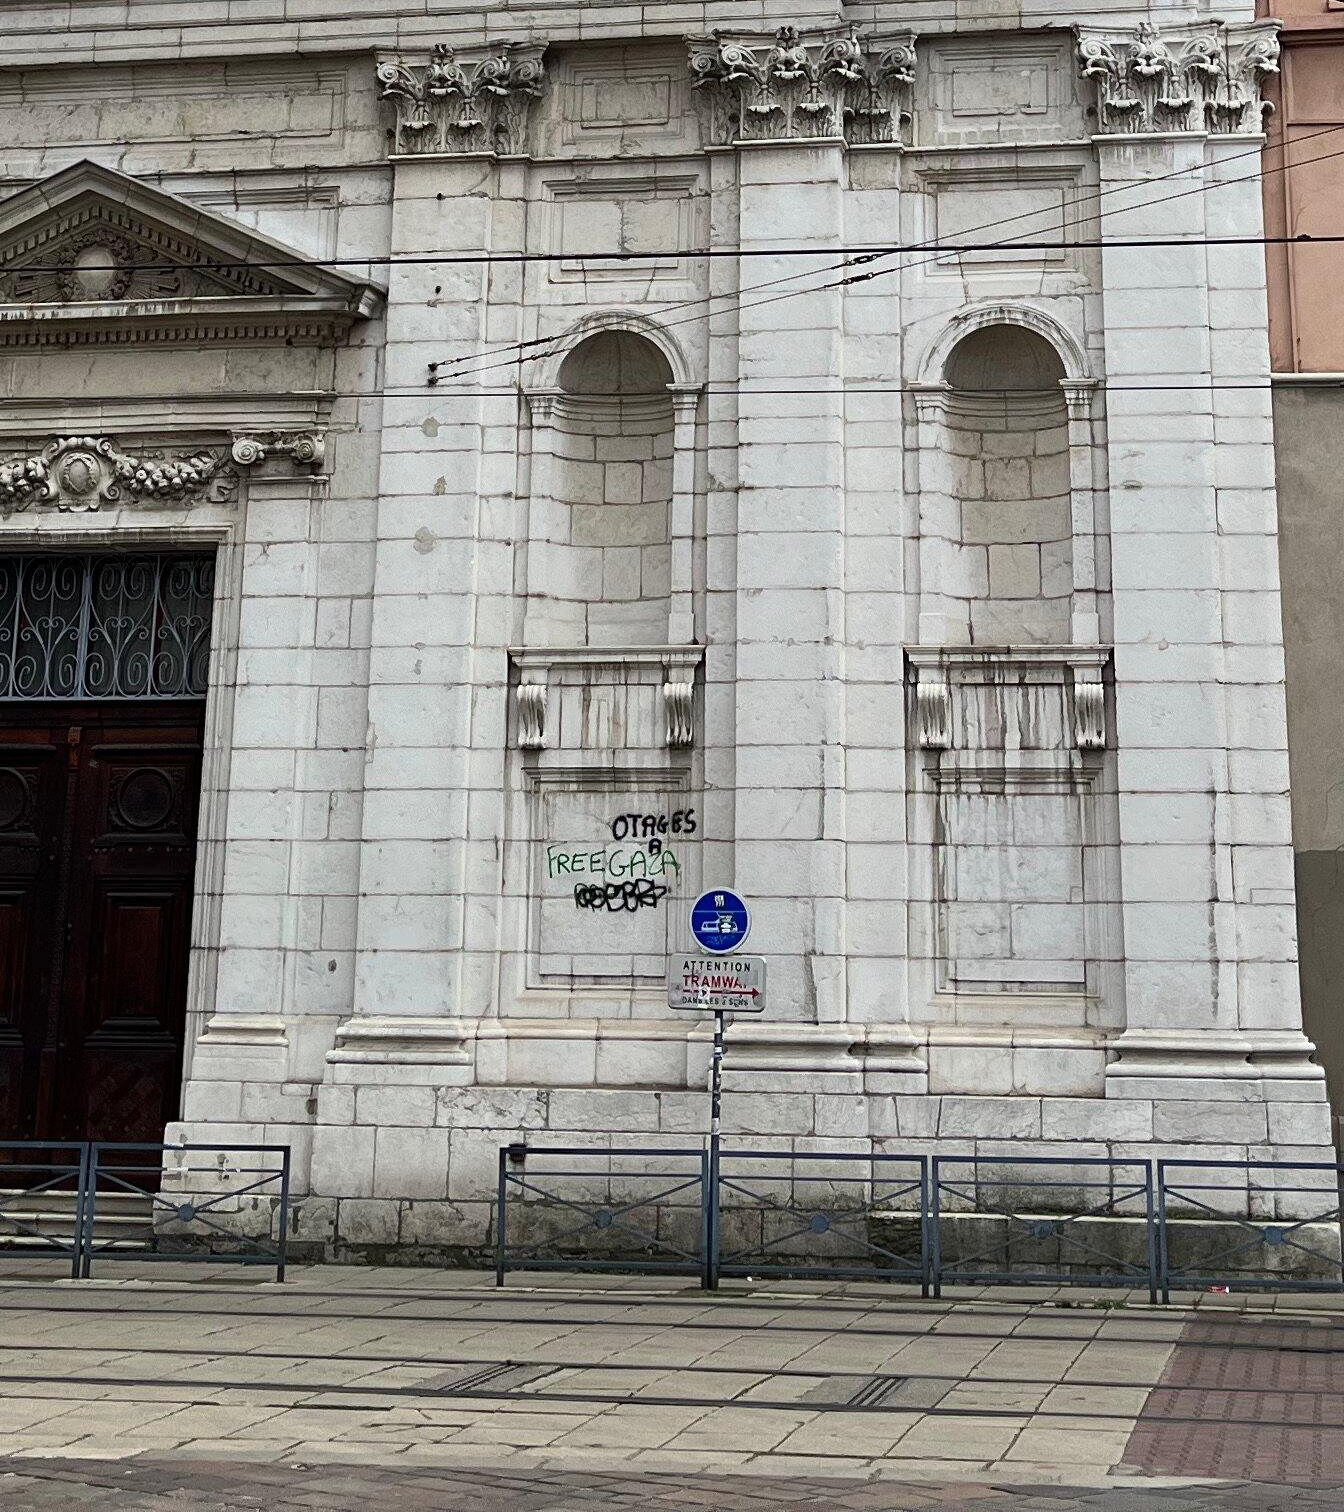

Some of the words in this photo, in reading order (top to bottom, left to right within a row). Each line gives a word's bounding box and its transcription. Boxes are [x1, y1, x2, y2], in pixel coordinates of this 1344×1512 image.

[612, 808, 697, 841] OTAGES
[547, 840, 606, 879] FREE
[683, 960, 751, 973] ATTENTION
[682, 974, 747, 989] TRAMWA
